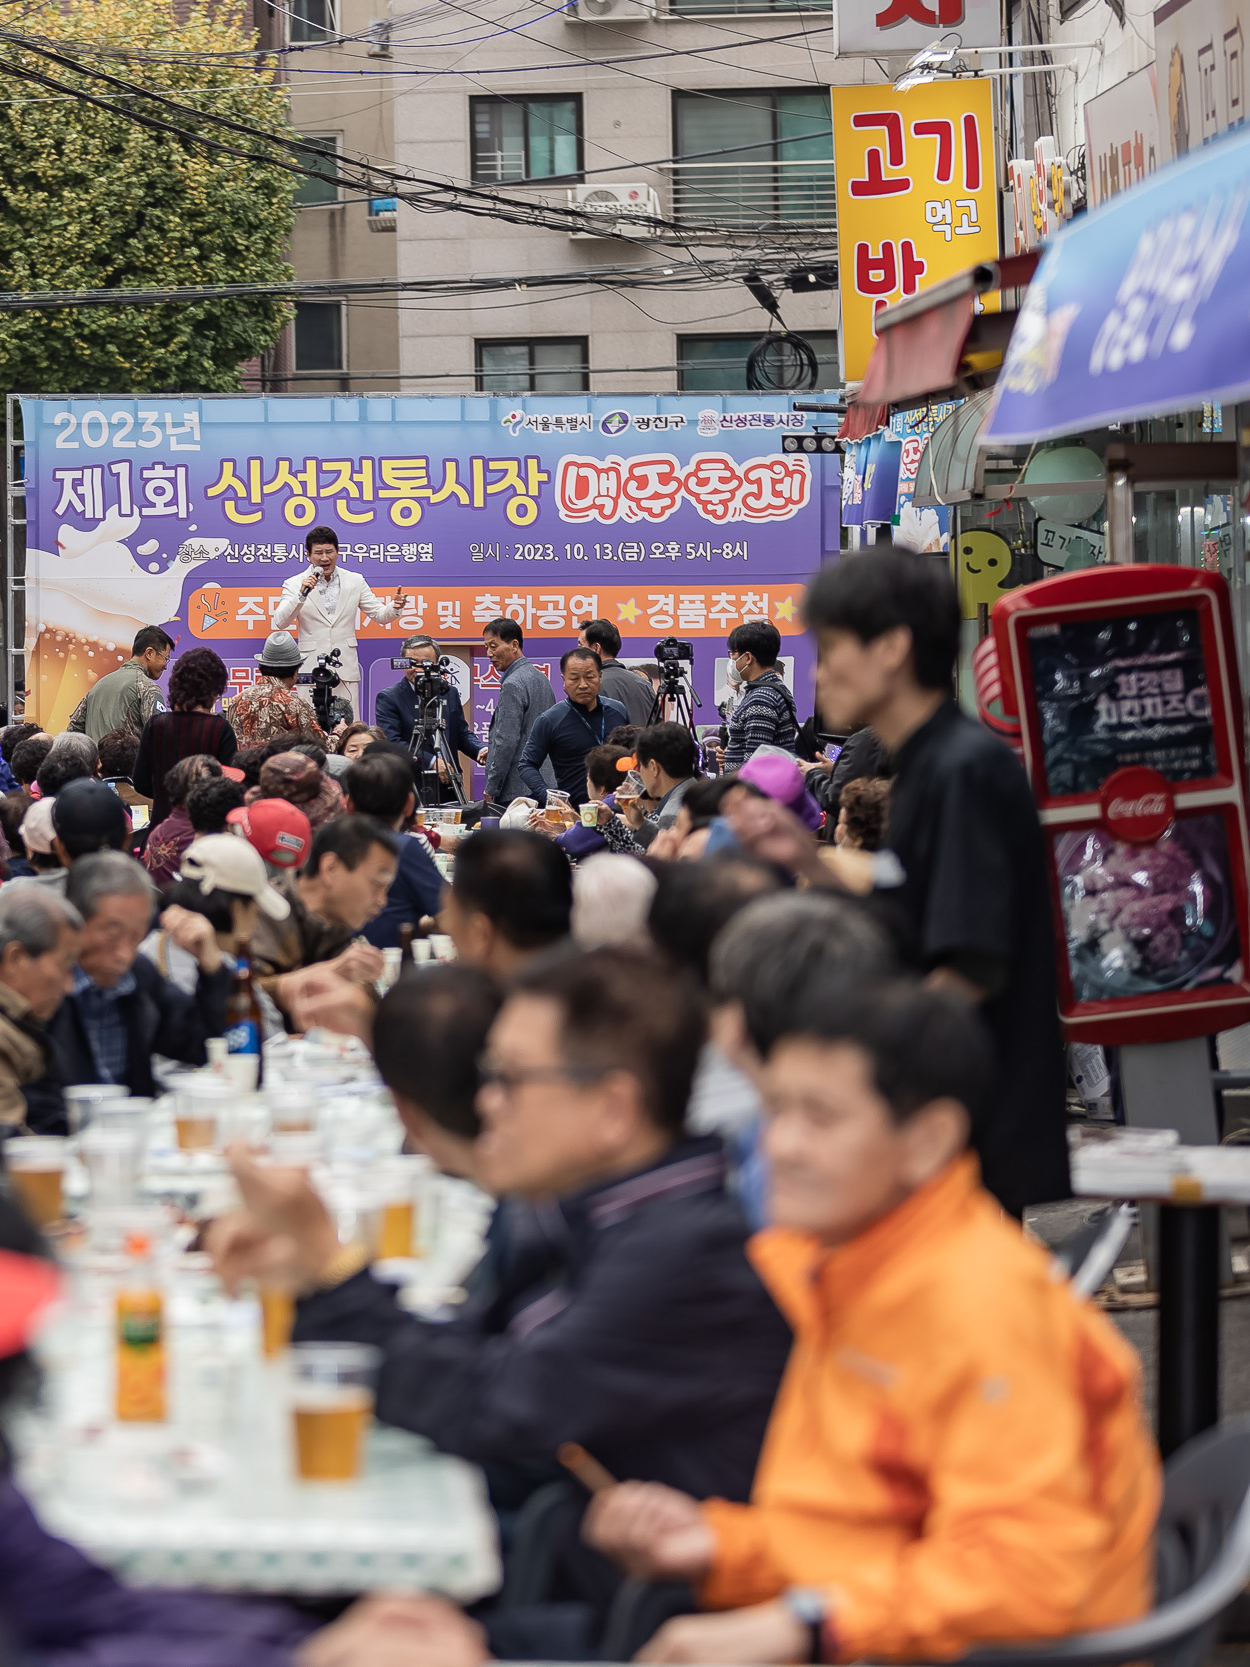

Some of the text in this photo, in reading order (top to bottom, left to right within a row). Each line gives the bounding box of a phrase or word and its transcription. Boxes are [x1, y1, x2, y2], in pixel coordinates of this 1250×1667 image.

[851, 112, 981, 197] 고기
[925, 199, 980, 241] 먹고
[54, 410, 201, 452] 2023년
[524, 413, 805, 432] 서울특별시 광진구 신성전통시장
[54, 460, 188, 520] 제1회
[206, 457, 549, 527] 신성전통시장
[557, 454, 811, 523] 맥주축제
[178, 543, 211, 563] 장소
[470, 542, 500, 562] 일시
[649, 541, 681, 561] 오후
[686, 540, 748, 561] 5시~8시
[436, 600, 461, 629] 및
[472, 593, 599, 629] 축하공연
[646, 592, 770, 629] 경품추첨
